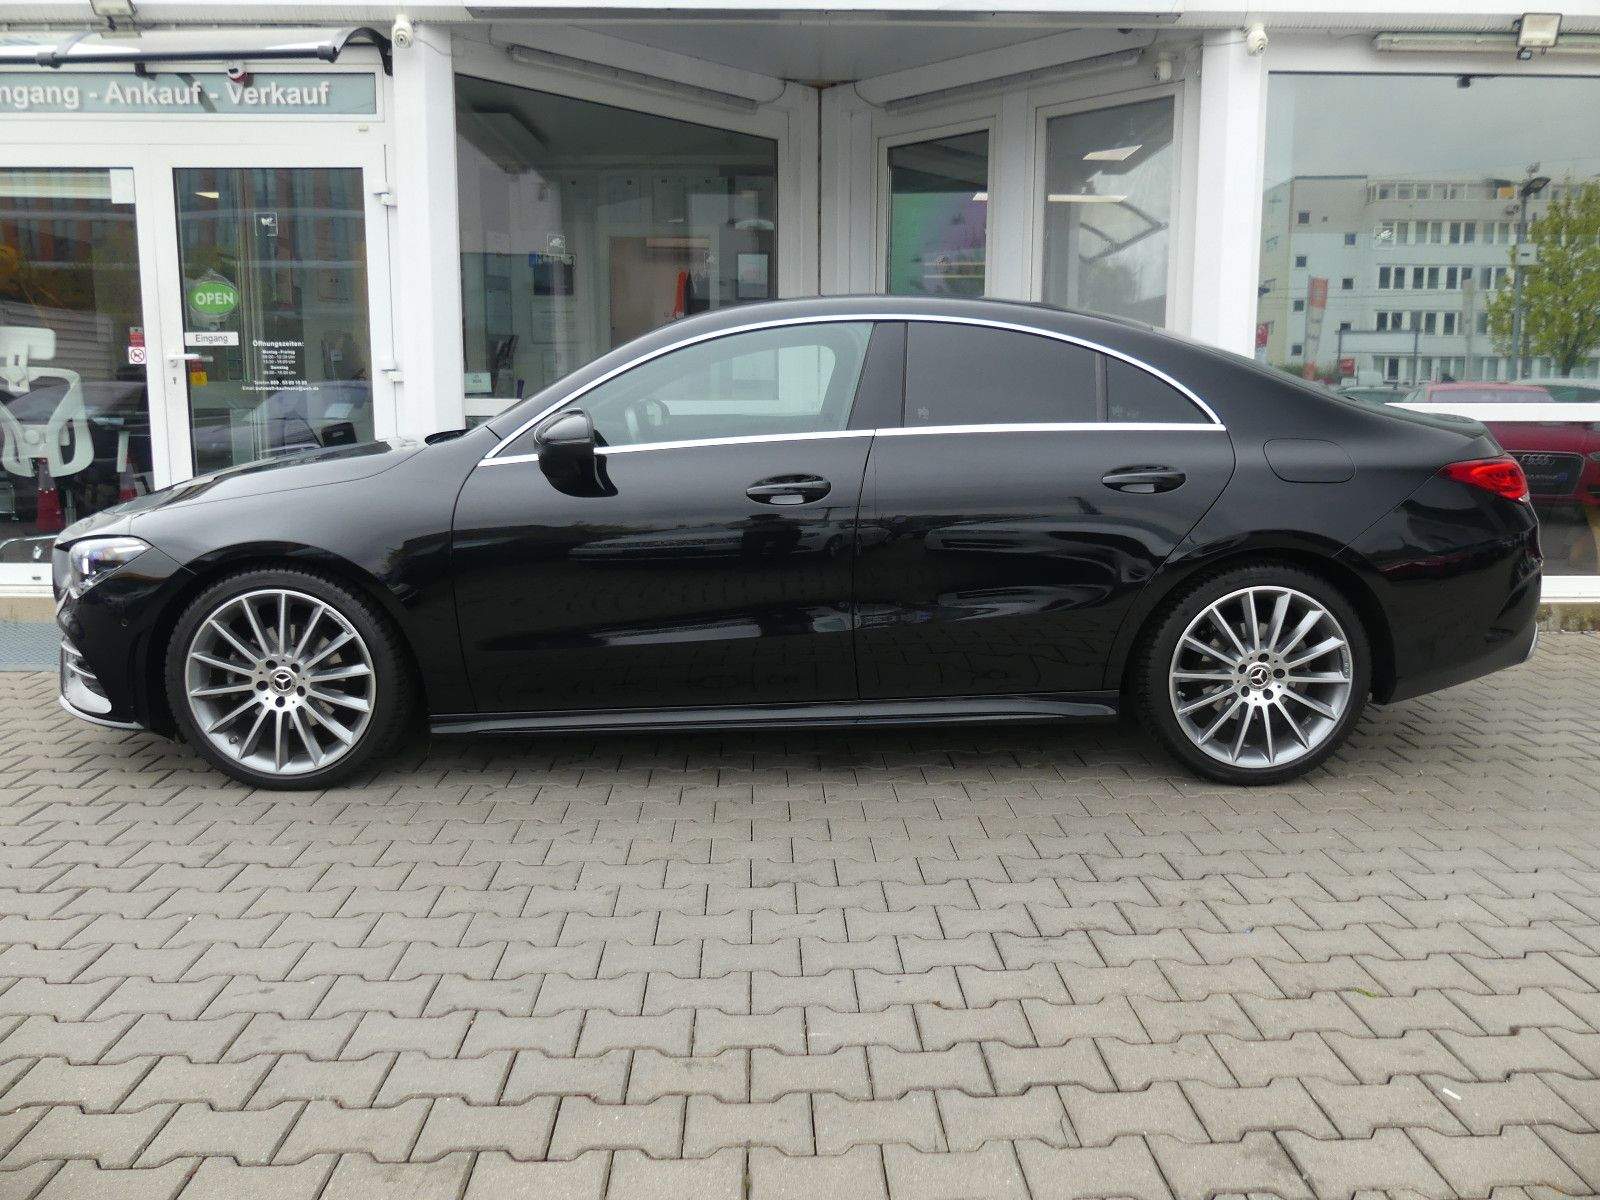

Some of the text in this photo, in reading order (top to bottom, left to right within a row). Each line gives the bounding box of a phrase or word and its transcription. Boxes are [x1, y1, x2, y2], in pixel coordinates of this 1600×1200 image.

[105, 80, 202, 105] Ankauf
[225, 81, 329, 105] Verkauf
[195, 292, 234, 306] OPEN
[195, 334, 228, 344] Eingang
